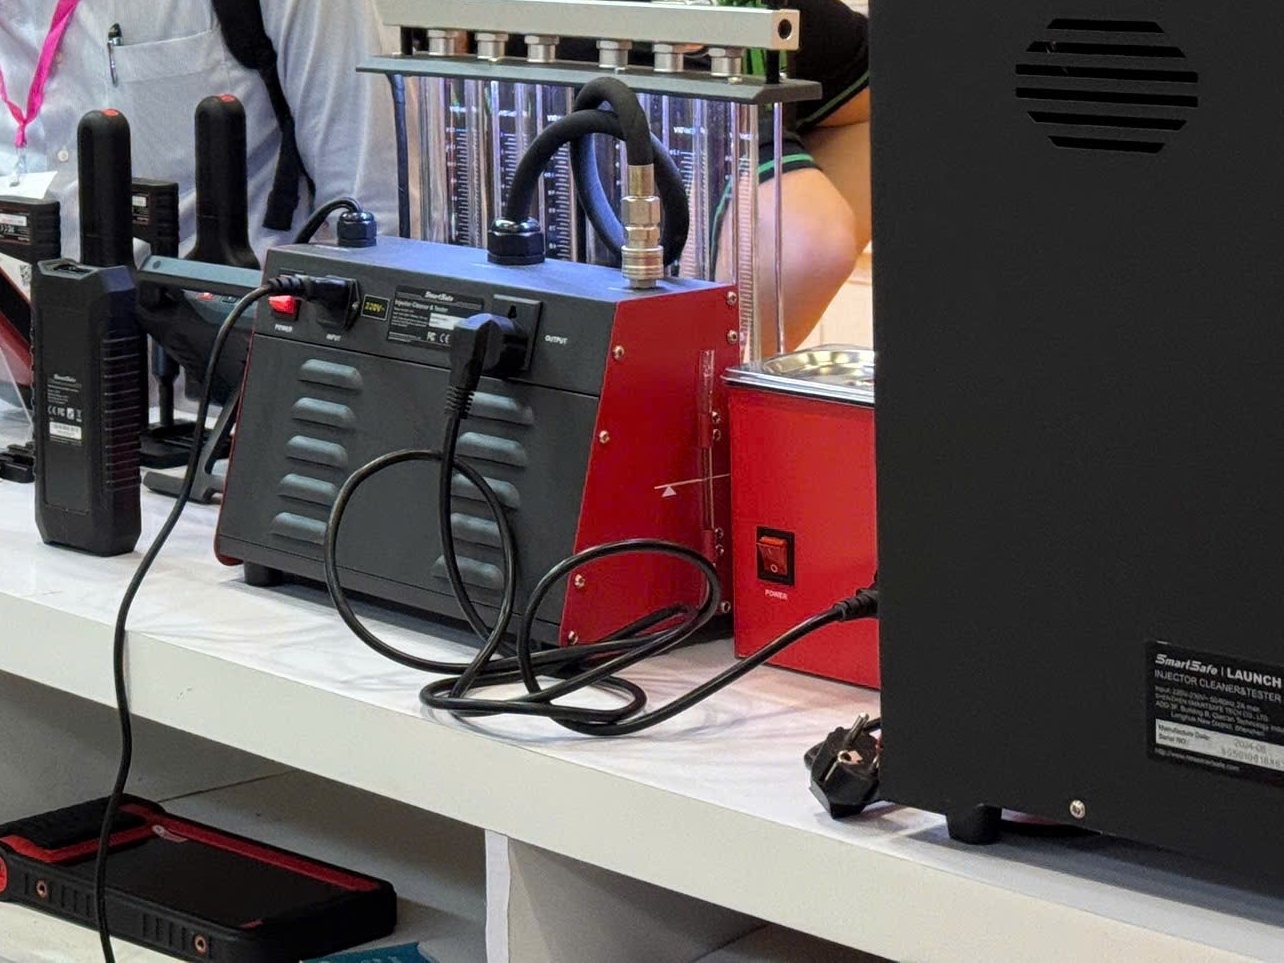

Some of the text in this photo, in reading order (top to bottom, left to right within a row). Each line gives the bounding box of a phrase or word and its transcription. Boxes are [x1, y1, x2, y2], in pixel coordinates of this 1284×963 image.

[765, 589, 789, 600] POWER
[1154, 669, 1283, 703] INJECTOR CLEANER&TESTER
[1155, 653, 1283, 689] SmartSafe LAUNCH
